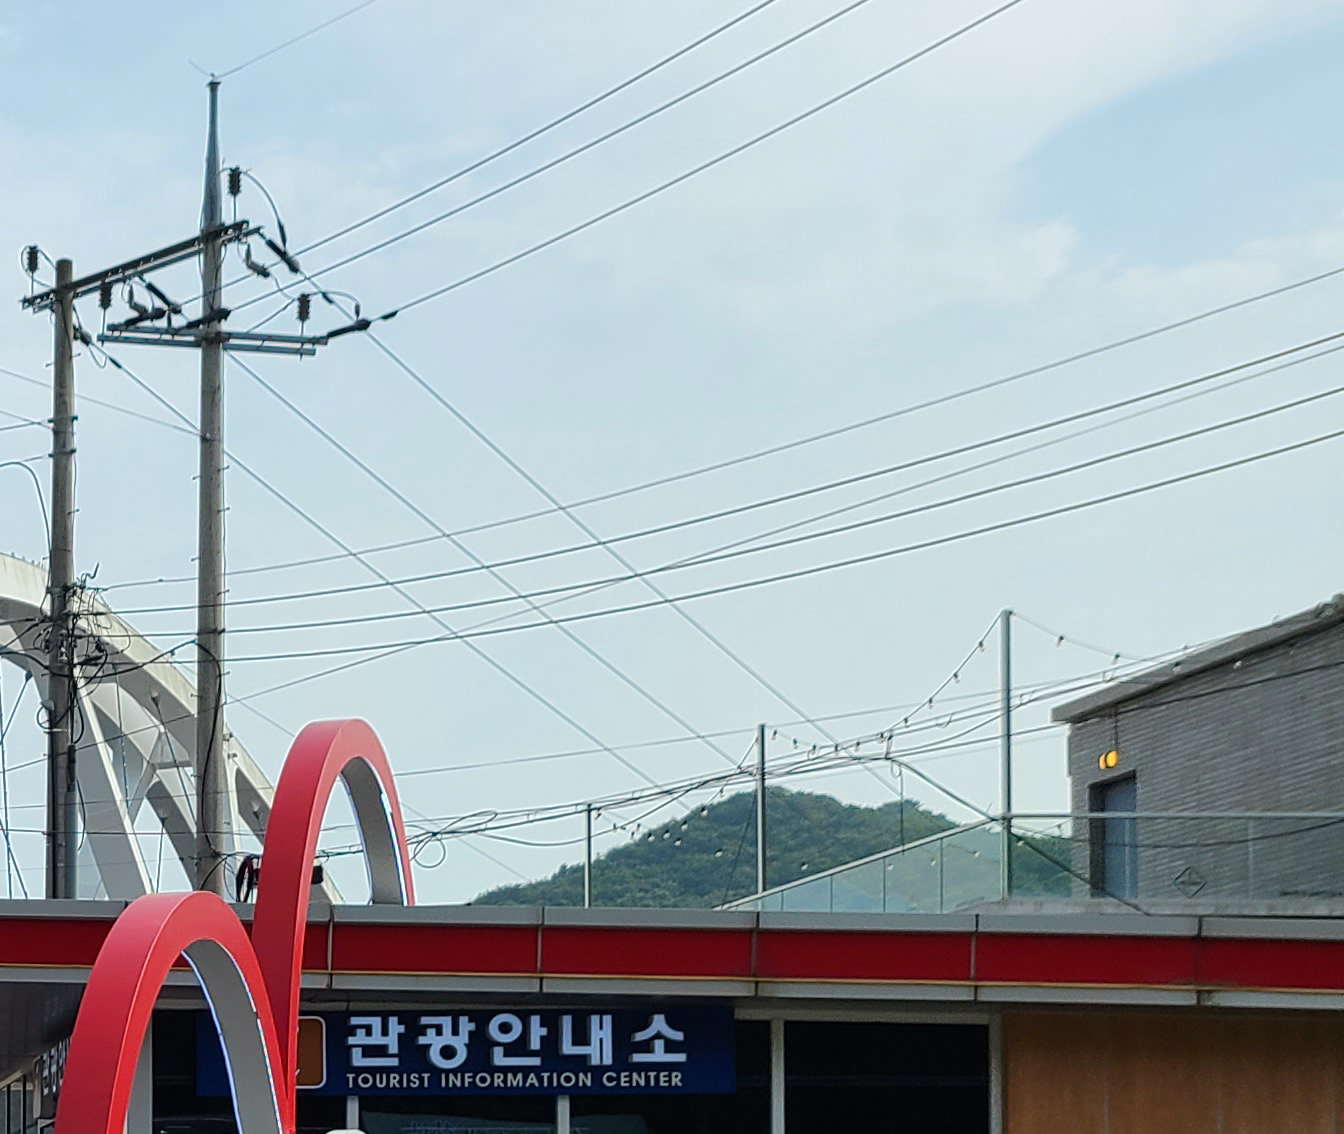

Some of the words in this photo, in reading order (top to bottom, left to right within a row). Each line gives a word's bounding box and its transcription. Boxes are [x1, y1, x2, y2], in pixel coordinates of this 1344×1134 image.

[346, 1012, 688, 1070] 관광안내소
[346, 1073, 431, 1089] TOURIST
[440, 1072, 593, 1089] INFORMATION
[602, 1071, 684, 1088] CENTER
